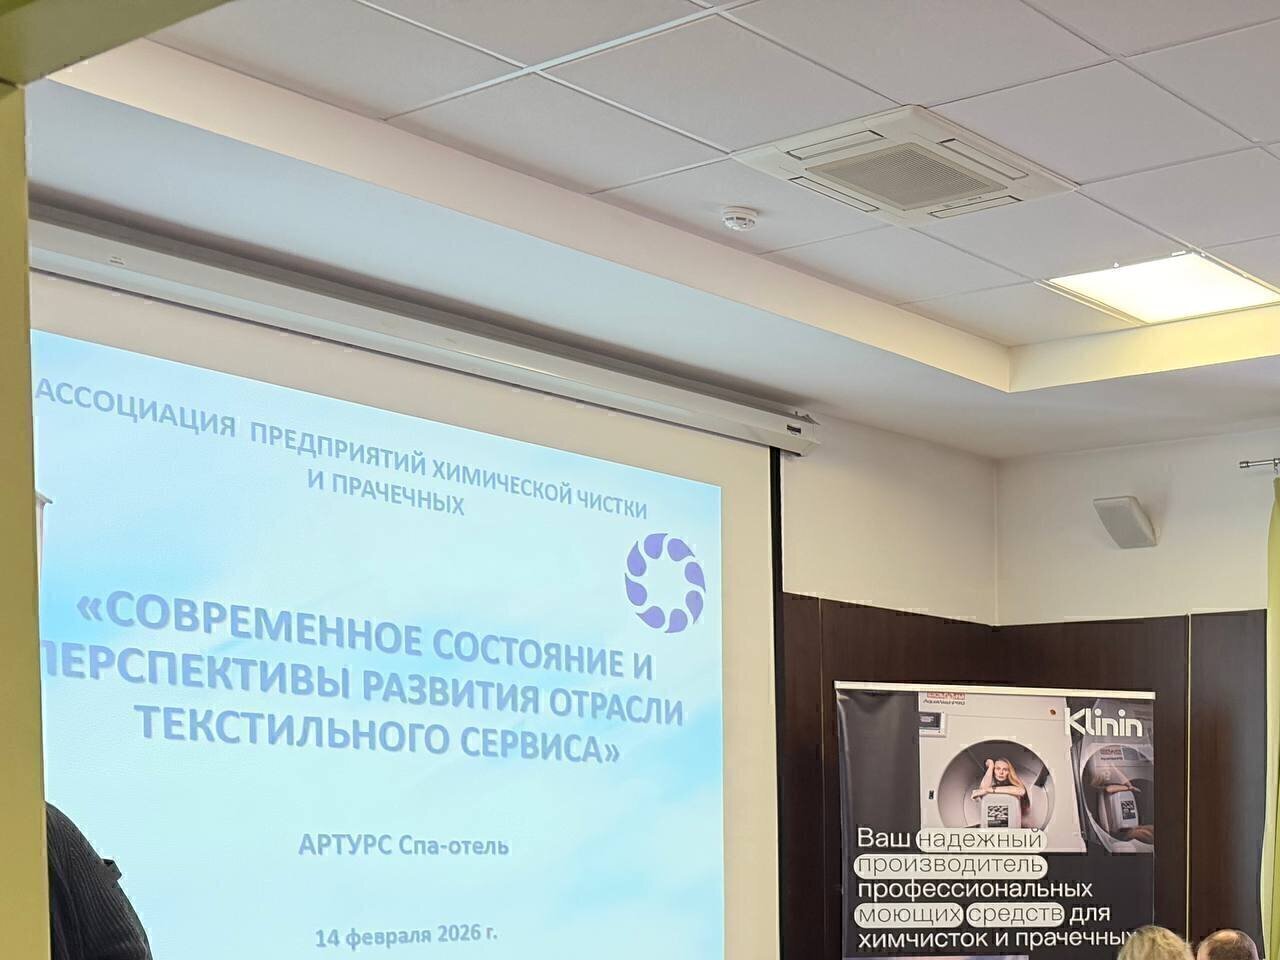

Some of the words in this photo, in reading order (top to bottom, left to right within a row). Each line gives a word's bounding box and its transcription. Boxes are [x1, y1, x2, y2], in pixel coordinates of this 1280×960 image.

[35, 377, 237, 438] АССОЦИАЦИЯ
[250, 421, 426, 478] ПРЕДПРИЯТИЙ
[432, 459, 571, 506] ХИМИЧЕСКОЙ
[576, 489, 648, 520] ЧИСТКИ
[307, 468, 325, 491] И
[331, 472, 465, 517] ПРАЧЕЧНЫХ
[76, 590, 424, 657] «СОВРЕМЕННОЕ
[432, 629, 624, 679] СОСТОЯНИЕ
[633, 653, 653, 681] И
[362, 669, 539, 714] РАЗВИТИЯ
[549, 688, 684, 726] ОТРАСЛИ
[134, 704, 450, 755] ТЕКСТИЛЬНОГО
[461, 731, 620, 765] СЕРВИСА»
[1063, 707, 1145, 738] Klinin
[298, 833, 392, 856] АРТУРС
[398, 835, 510, 857] Спа-отель
[857, 828, 911, 848] Ваш
[919, 827, 1043, 850] надежный
[857, 855, 1043, 876] производитель
[858, 879, 1093, 903] профессиональных
[859, 906, 962, 925] моющих
[968, 905, 1063, 925] средств
[1069, 907, 1111, 926] для
[315, 928, 340, 948] 14
[346, 927, 432, 951] февраля
[438, 923, 481, 943] 2026
[486, 926, 498, 941] г.
[858, 932, 989, 949] химчисток
[995, 932, 1009, 947] и
